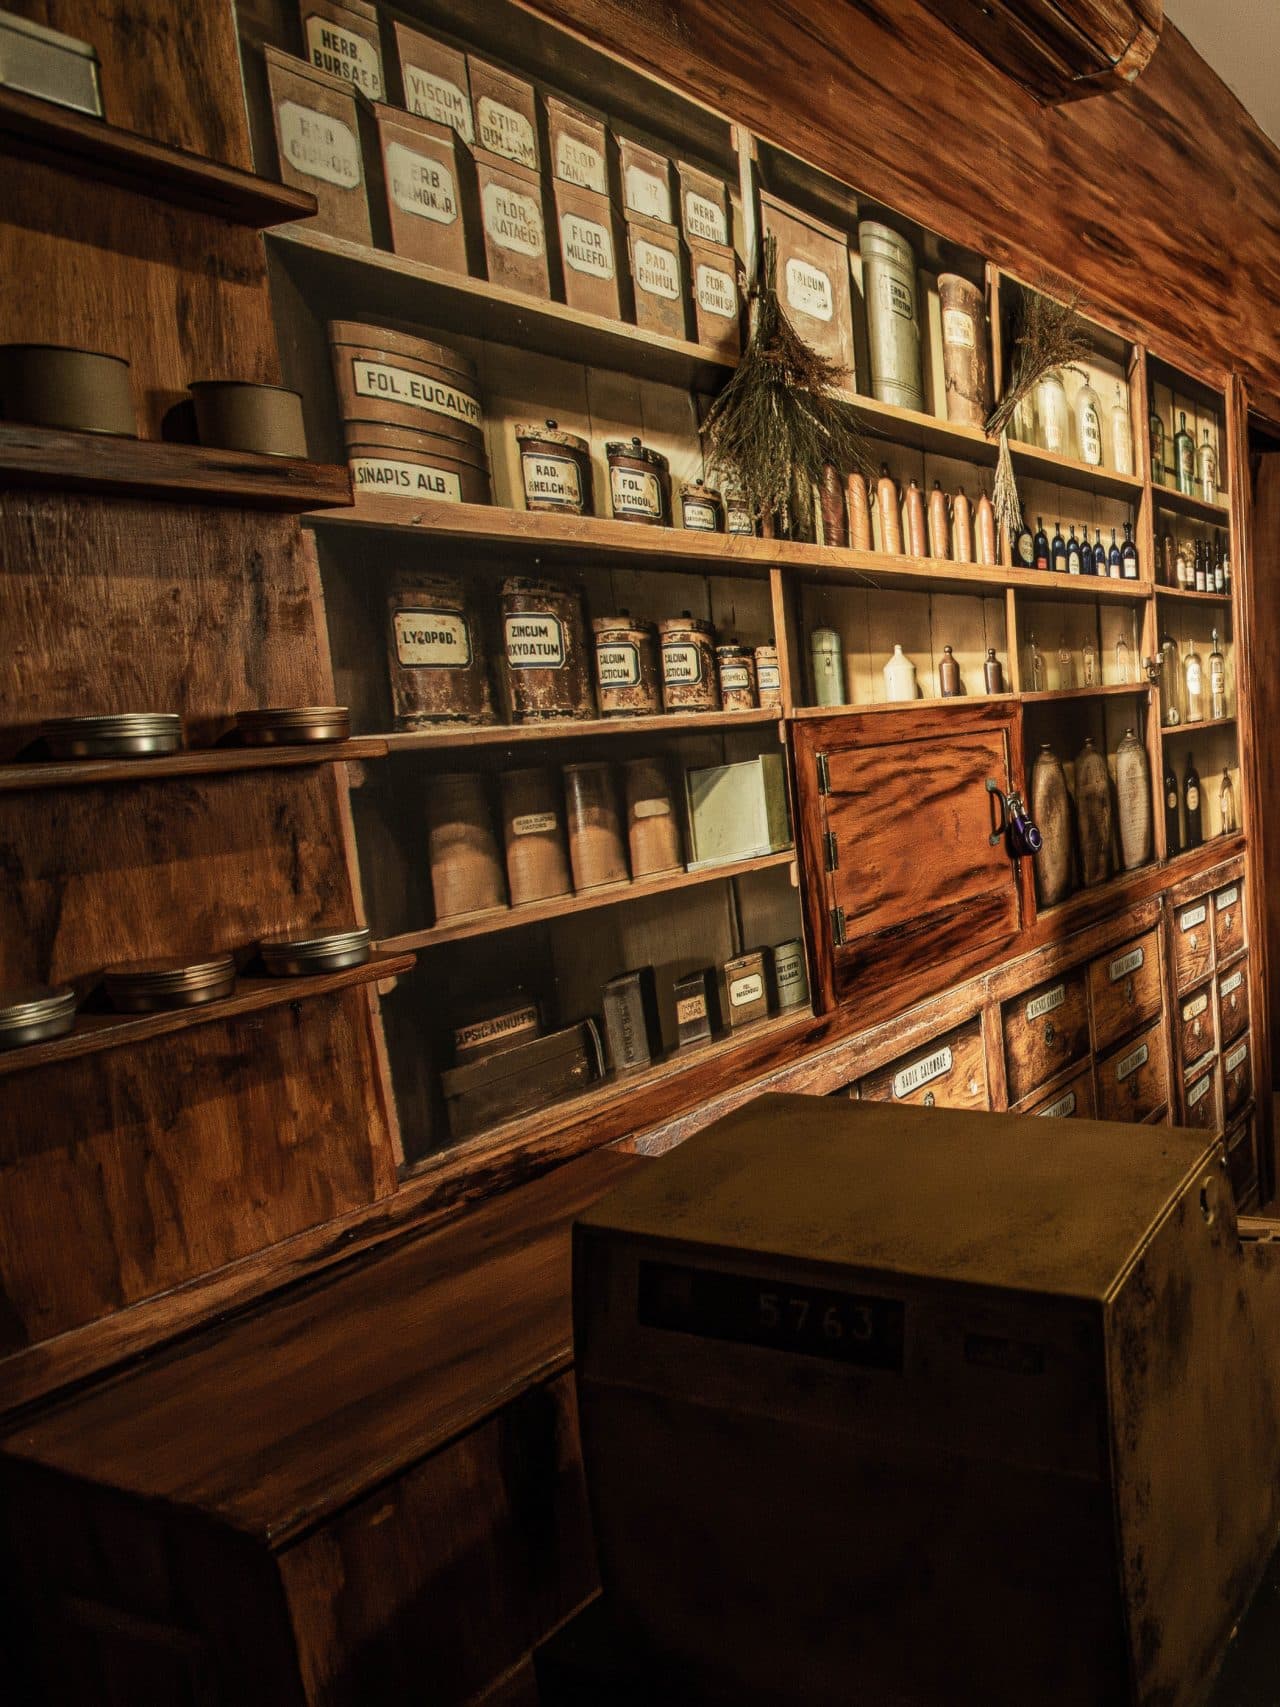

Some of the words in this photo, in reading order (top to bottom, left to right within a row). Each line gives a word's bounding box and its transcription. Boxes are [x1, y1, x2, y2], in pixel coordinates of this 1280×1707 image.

[321, 28, 362, 62] HERB.
[313, 47, 369, 87] BURSAE
[410, 74, 463, 114] VISCUM
[366, 371, 408, 396] FOL.
[357, 466, 411, 488] SINAPIS
[417, 473, 453, 495] ALB.
[535, 465, 559, 478] RAD.
[622, 479, 643, 492] FOL.
[402, 631, 457, 645] LYCOPOD.
[511, 625, 549, 638] ZINCUM
[508, 643, 560, 656] OXYDATUM
[758, 1292, 873, 1340] 5763
